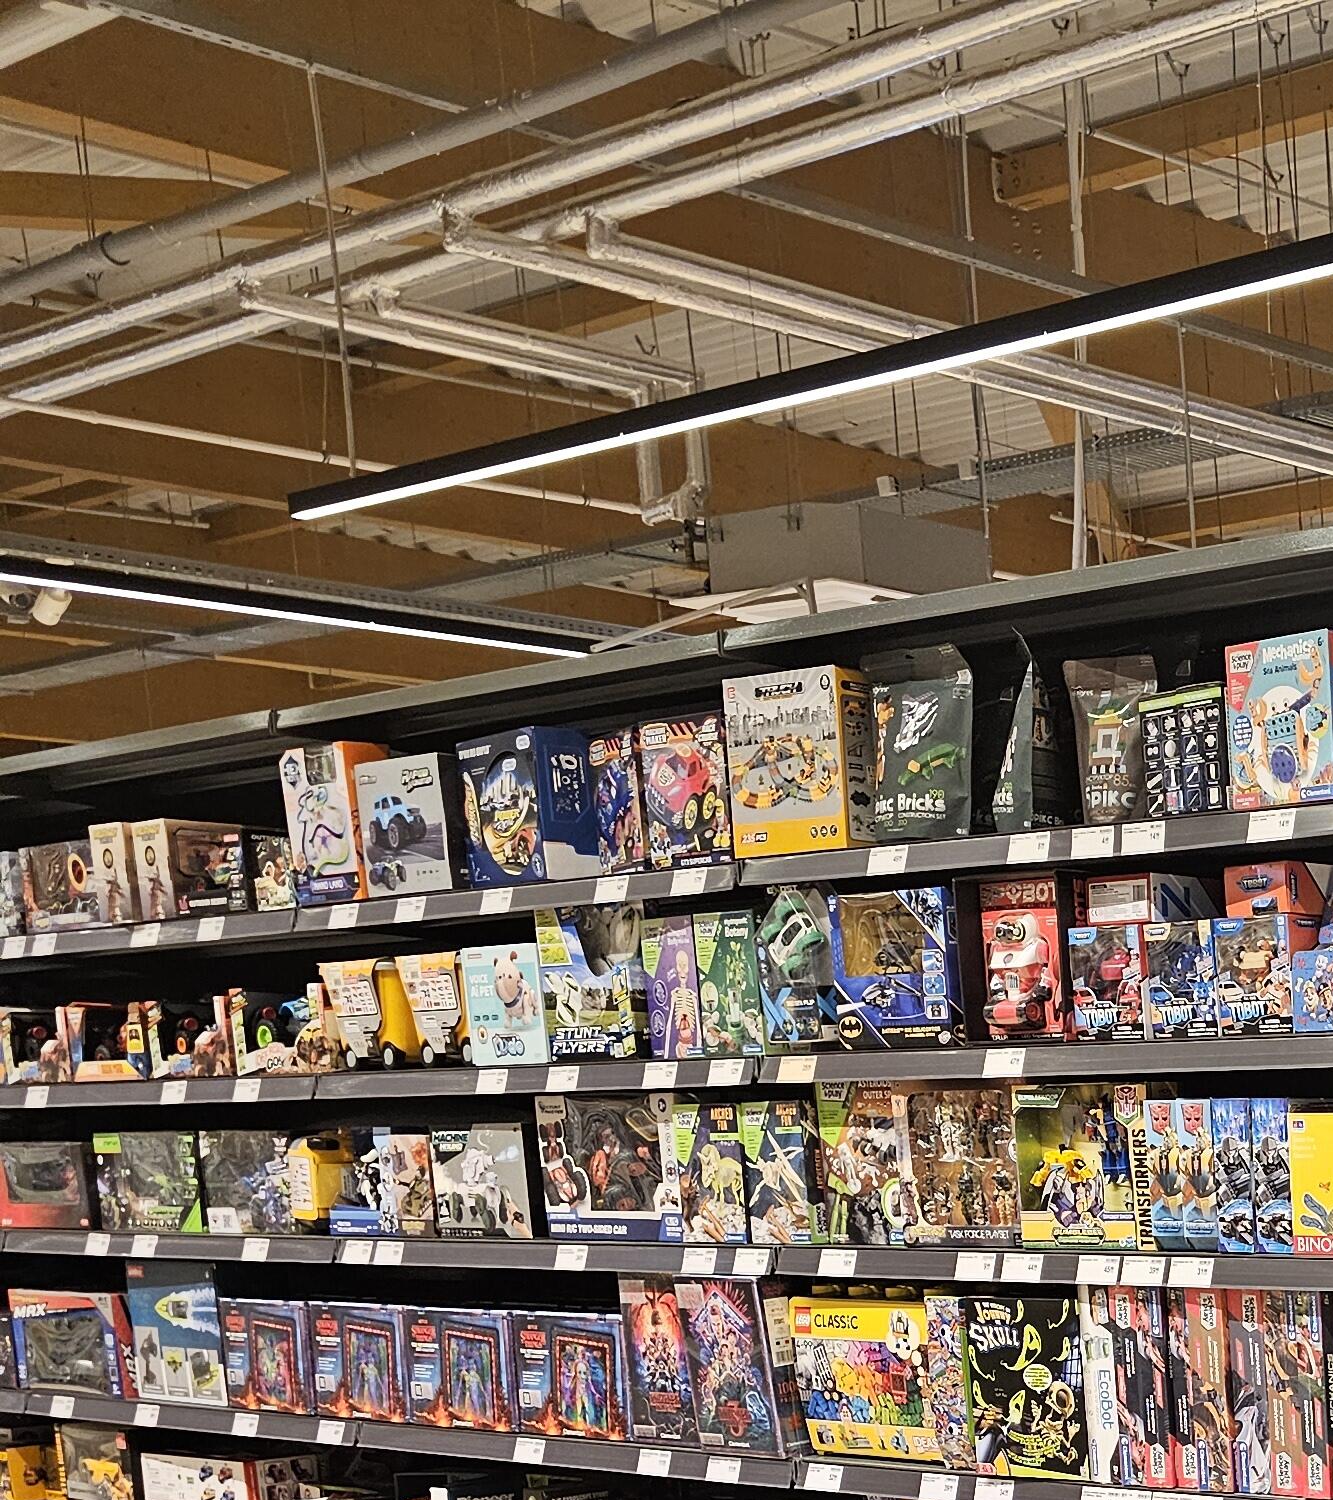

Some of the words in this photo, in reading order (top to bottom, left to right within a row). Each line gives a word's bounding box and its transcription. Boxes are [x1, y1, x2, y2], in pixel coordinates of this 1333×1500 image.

[1230, 652, 1251, 664] Science
[898, 790, 946, 813] Bricks
[1228, 999, 1267, 1021] TOBOT
[1131, 1128, 1153, 1248] TRANSFORMERS
[814, 1313, 858, 1330] CLASSIC
[970, 1326, 1020, 1352] SKULL
[1098, 1369, 1114, 1430] EcoBot
